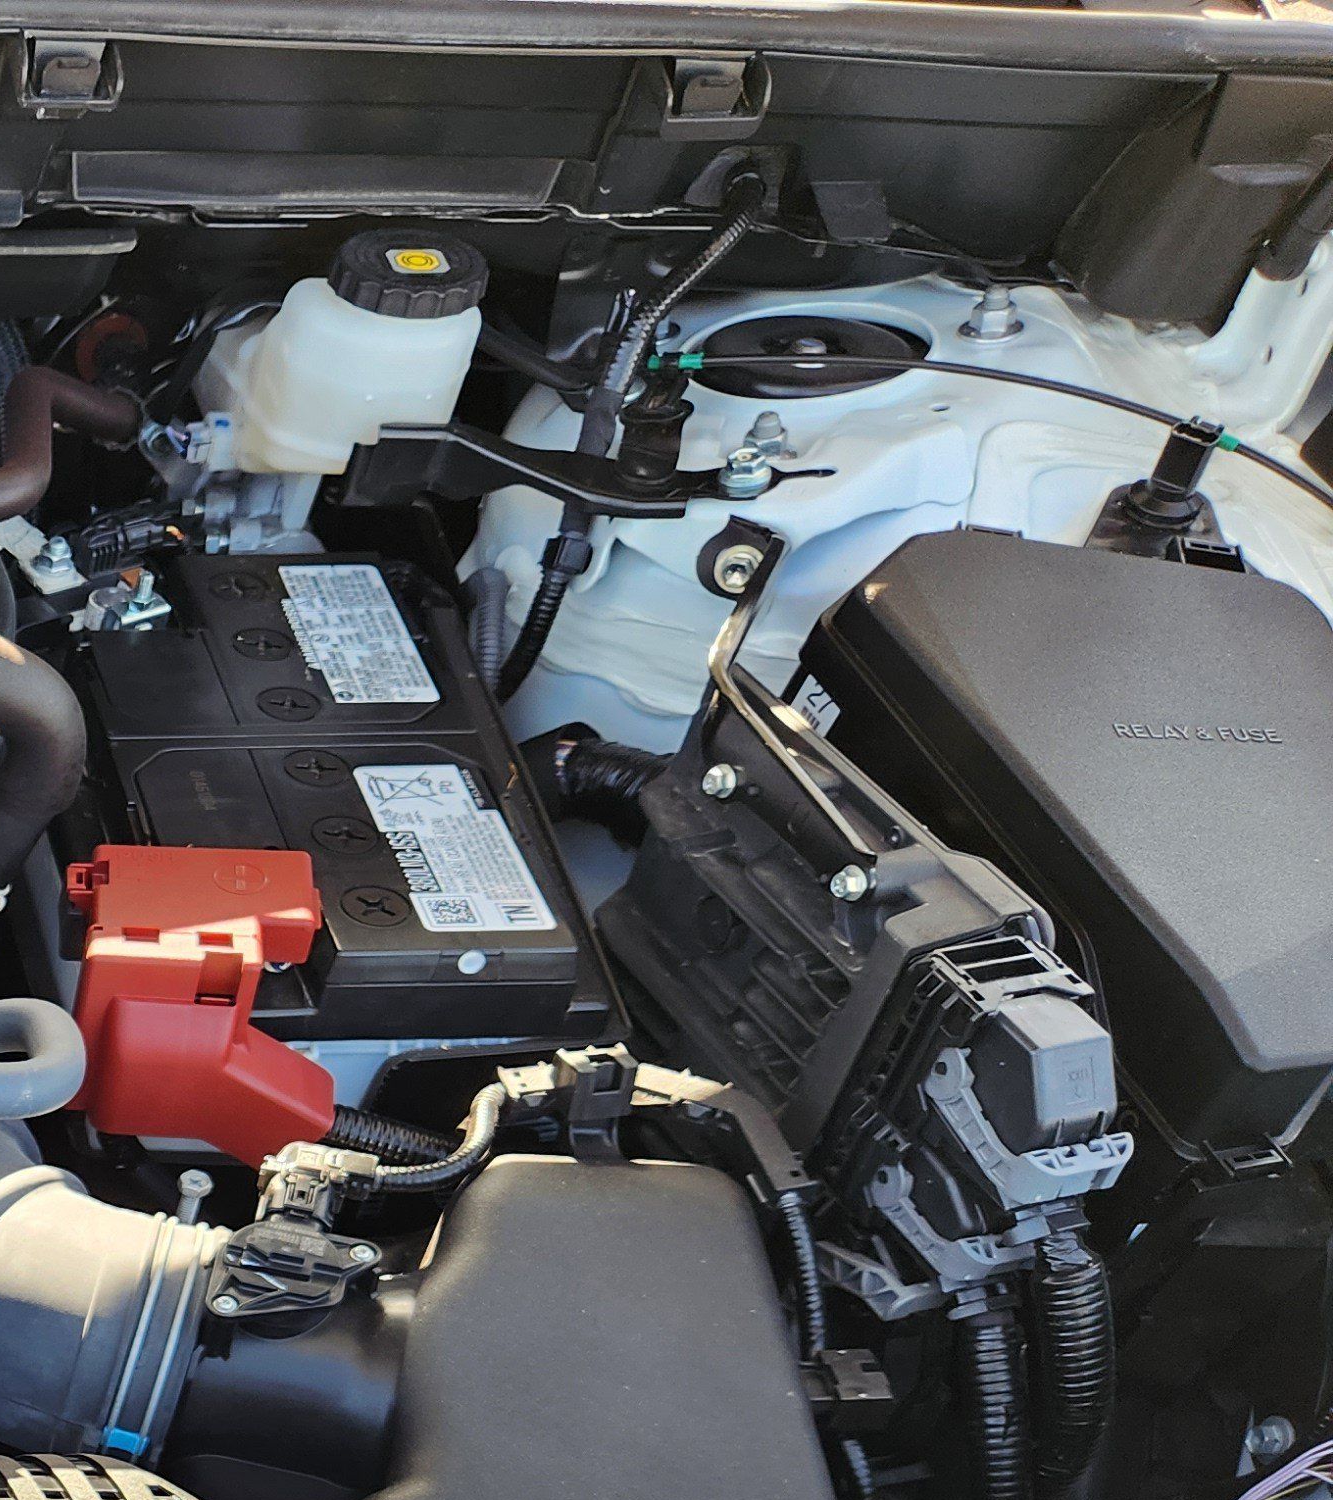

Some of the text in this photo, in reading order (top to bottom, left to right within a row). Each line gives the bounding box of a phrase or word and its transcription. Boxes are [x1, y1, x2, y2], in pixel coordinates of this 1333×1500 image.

[1113, 722, 1283, 744] RELAY & FUSE
